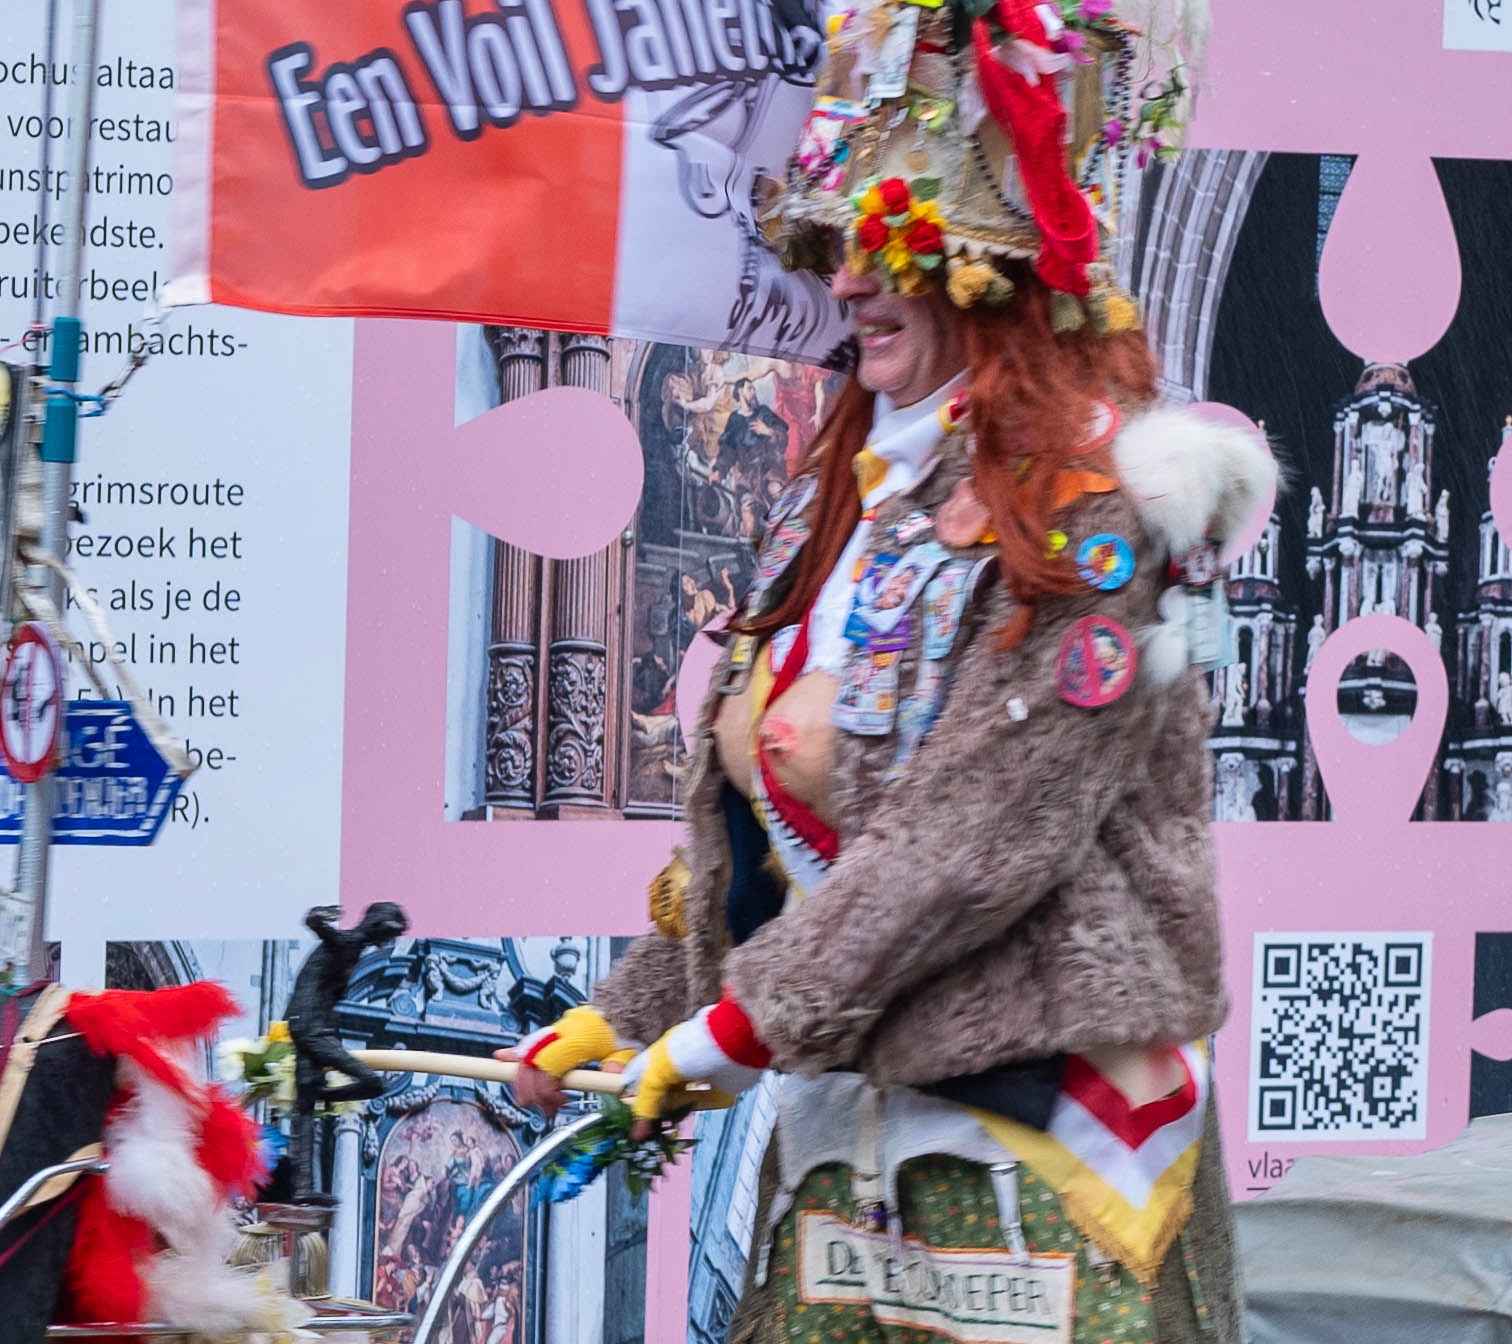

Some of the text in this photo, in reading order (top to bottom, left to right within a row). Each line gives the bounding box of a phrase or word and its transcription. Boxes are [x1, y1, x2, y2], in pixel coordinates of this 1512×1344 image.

[269, 45, 424, 187] Een
[66, 475, 244, 515] grimsroute
[189, 527, 242, 559] het
[110, 579, 154, 611] als
[161, 581, 191, 620] je
[203, 580, 240, 612] de
[150, 634, 176, 664] in
[190, 633, 239, 664] het
[189, 686, 239, 717] het
